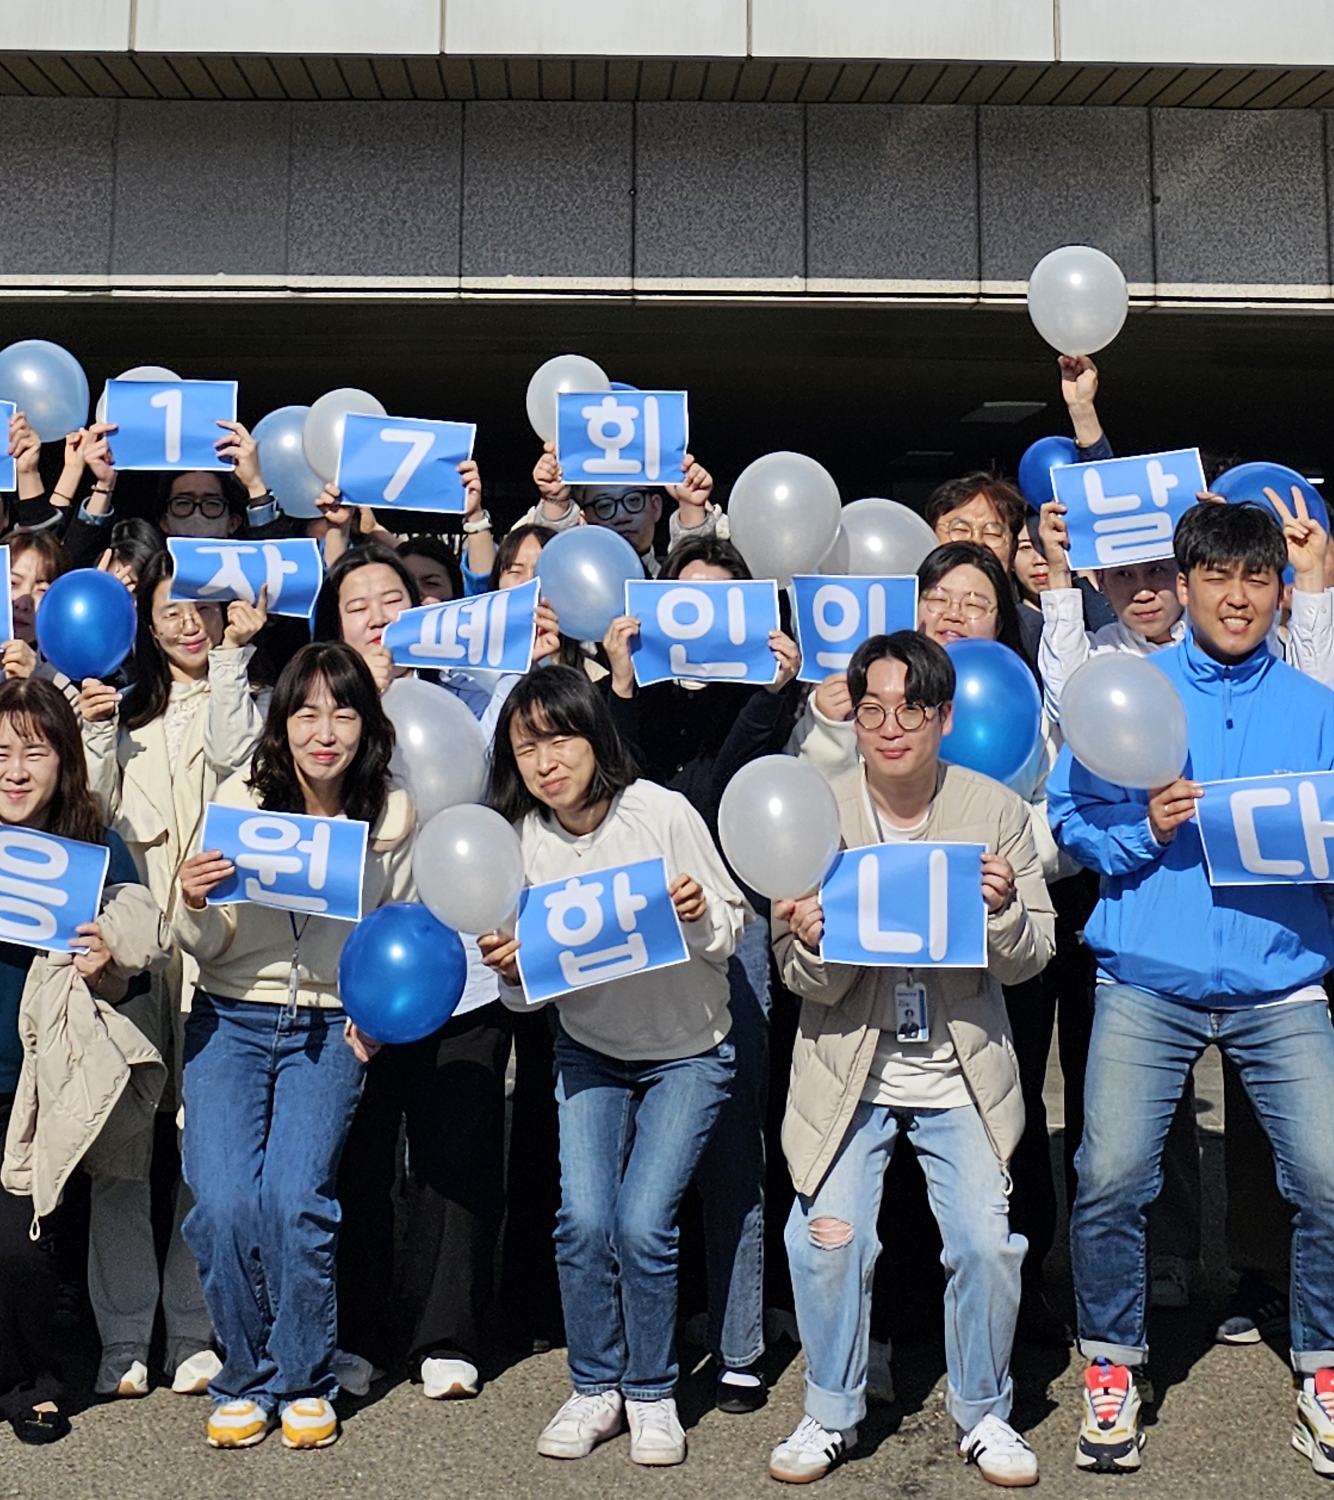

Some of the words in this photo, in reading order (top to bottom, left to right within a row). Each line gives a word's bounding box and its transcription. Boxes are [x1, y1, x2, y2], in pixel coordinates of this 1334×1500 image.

[148, 389, 183, 464] 1
[378, 428, 438, 503] 7
[581, 396, 662, 481] 회
[407, 591, 511, 669] 폐
[655, 585, 748, 679] 인
[237, 816, 332, 914] 원
[545, 875, 649, 990] 합
[857, 848, 949, 963] 니
